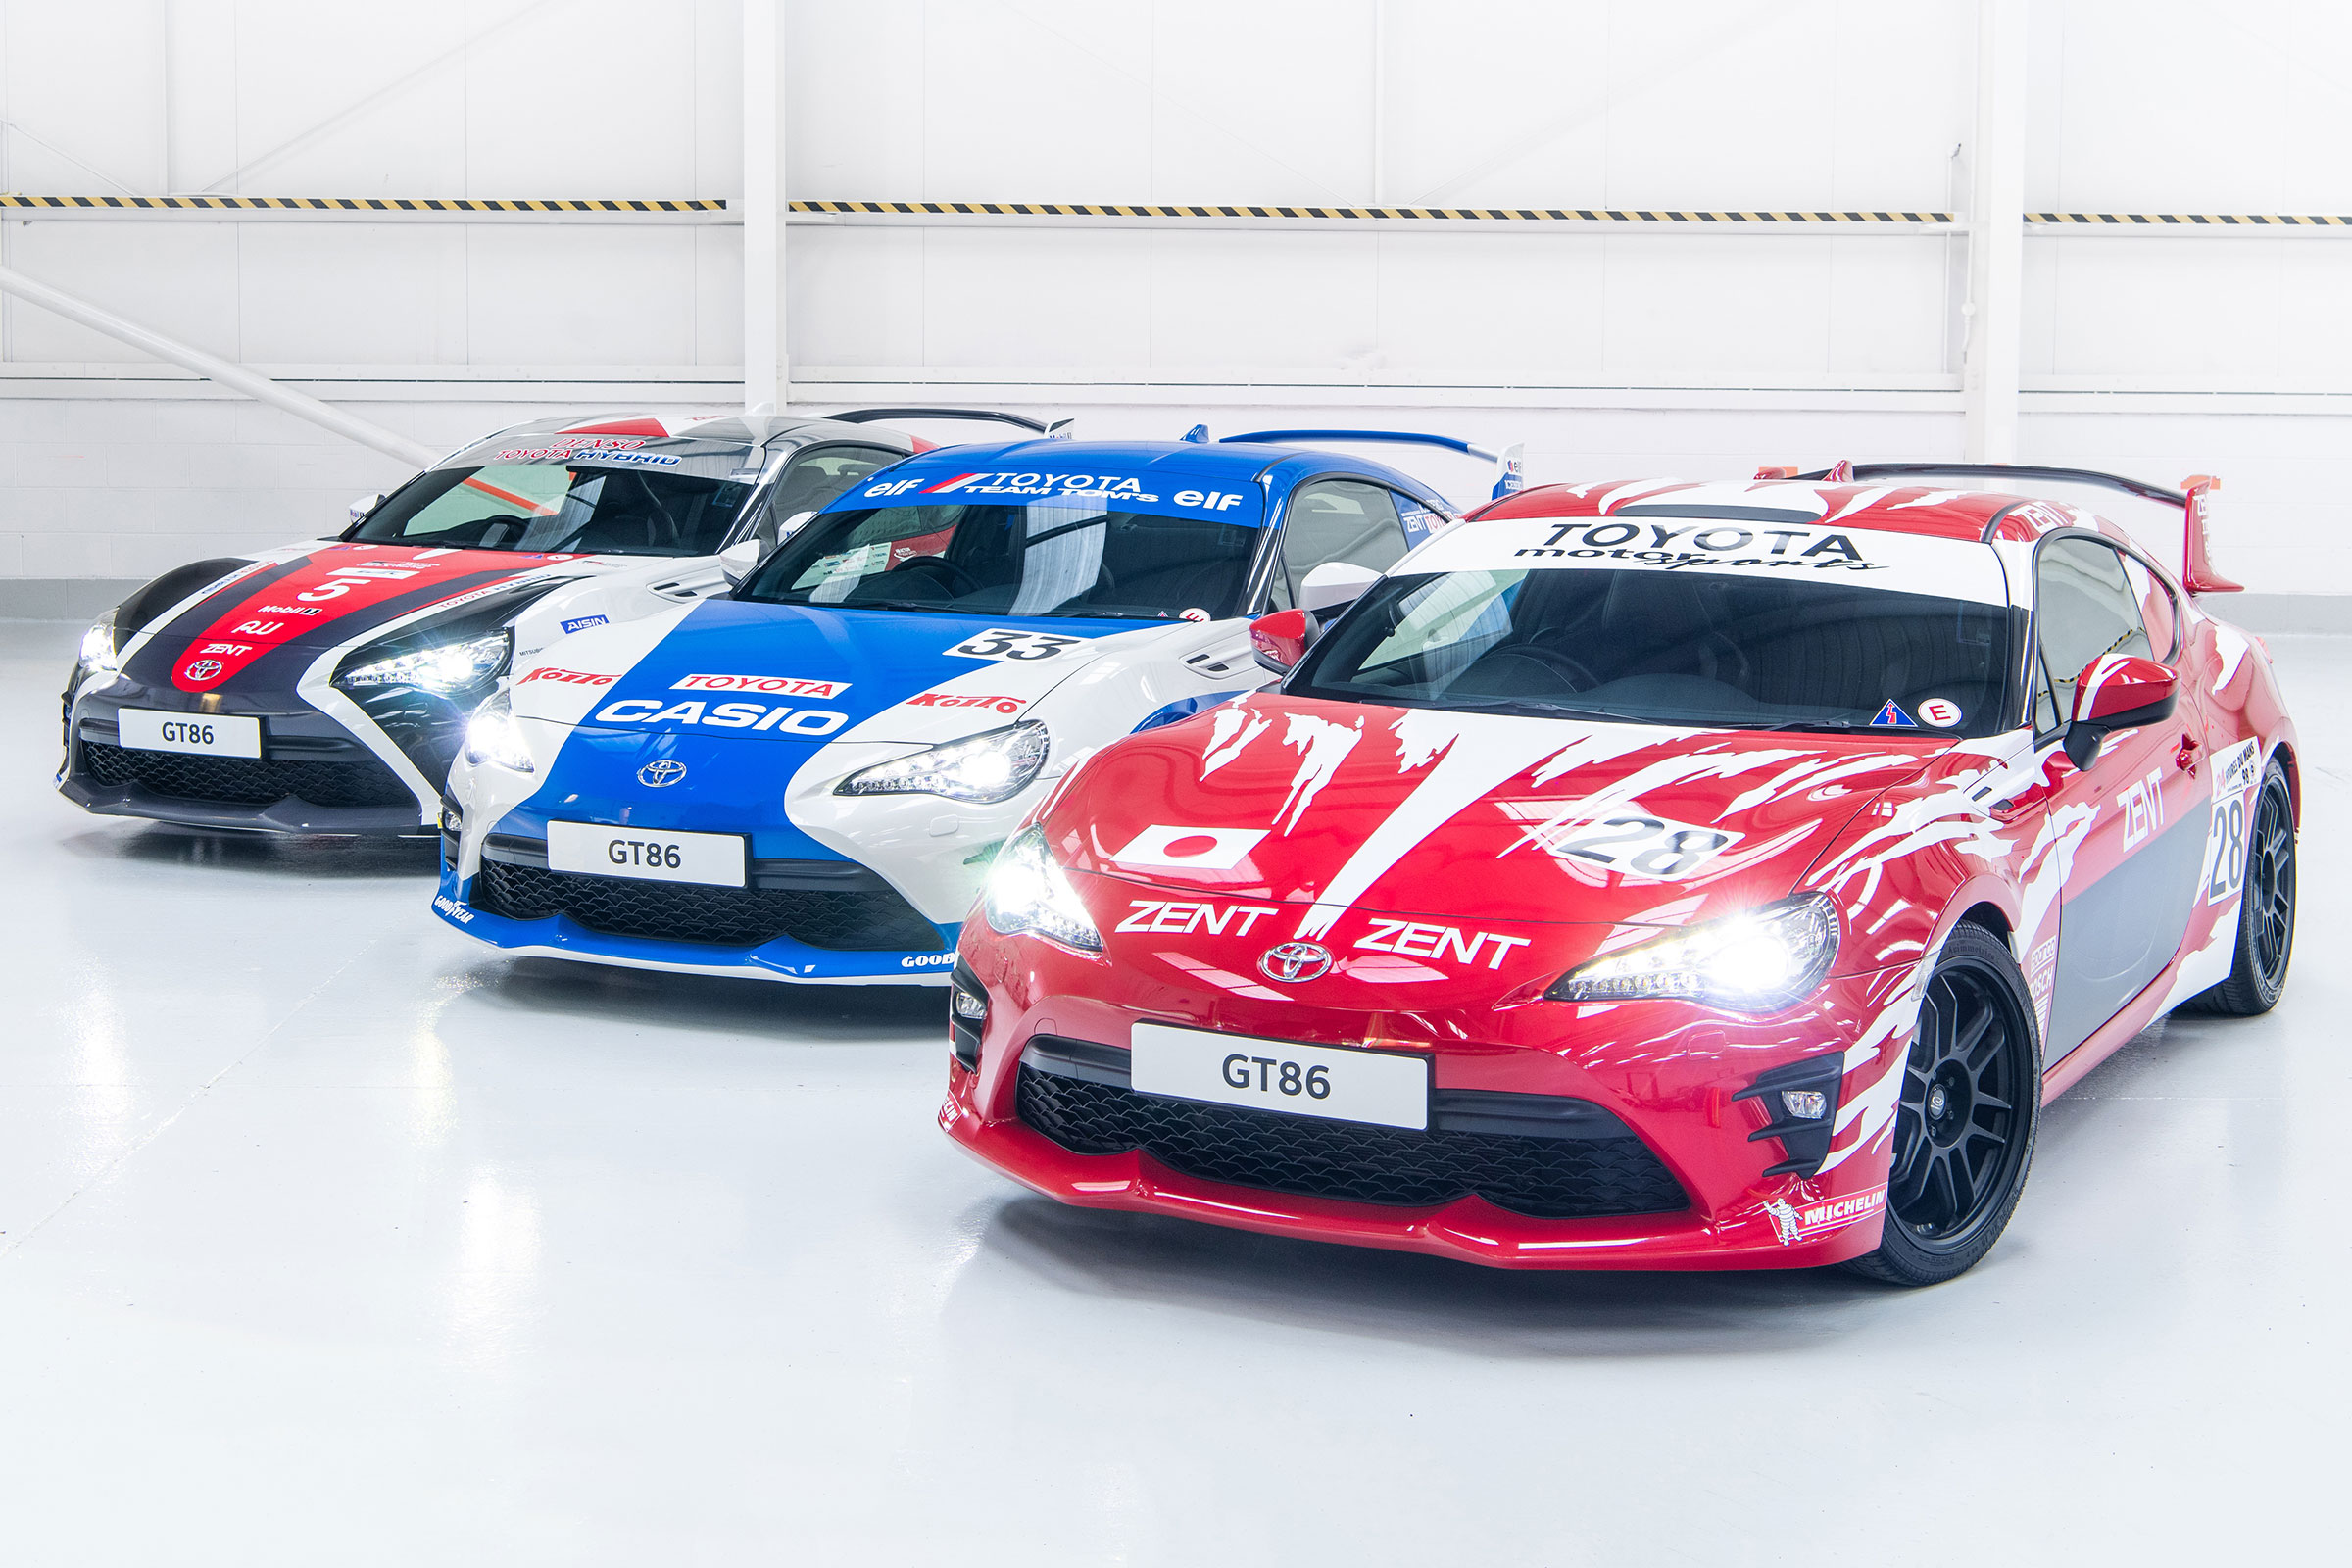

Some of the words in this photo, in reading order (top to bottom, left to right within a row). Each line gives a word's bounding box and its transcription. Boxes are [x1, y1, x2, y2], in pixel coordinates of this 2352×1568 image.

[552, 438, 646, 450] DENSO
[495, 449, 571, 460] TOYOTA
[575, 449, 682, 466] HYBRID
[864, 478, 924, 498] elf
[992, 472, 1141, 491] TOYOTA
[964, 485, 1054, 494] TEAM
[1057, 488, 1159, 503] TOM'S
[1174, 490, 1244, 512] elf
[1403, 514, 1427, 533] ZENT
[2008, 501, 2070, 534] ZENT
[1544, 523, 1863, 561] TOYOTA
[297, 578, 371, 601] 5
[258, 605, 306, 614] Mobil
[567, 617, 606, 632] AISIN
[200, 643, 253, 657] ZENT
[958, 631, 1081, 661] 33
[685, 675, 833, 697] TOYOTA
[595, 699, 850, 736] CASIO
[1929, 705, 1951, 721] E
[162, 721, 215, 745] GT86
[2116, 766, 2165, 854] ZENT
[608, 839, 681, 869] GT86
[1556, 815, 1729, 875] 28
[2210, 799, 2243, 899] 28
[434, 895, 475, 924] GOODYEAR
[1114, 900, 1279, 937] ZENT
[1353, 917, 1531, 970] ZENT
[901, 952, 956, 968] GOOD
[1222, 1054, 1331, 1099] GT86
[1804, 1189, 1886, 1226] MICHELIN
